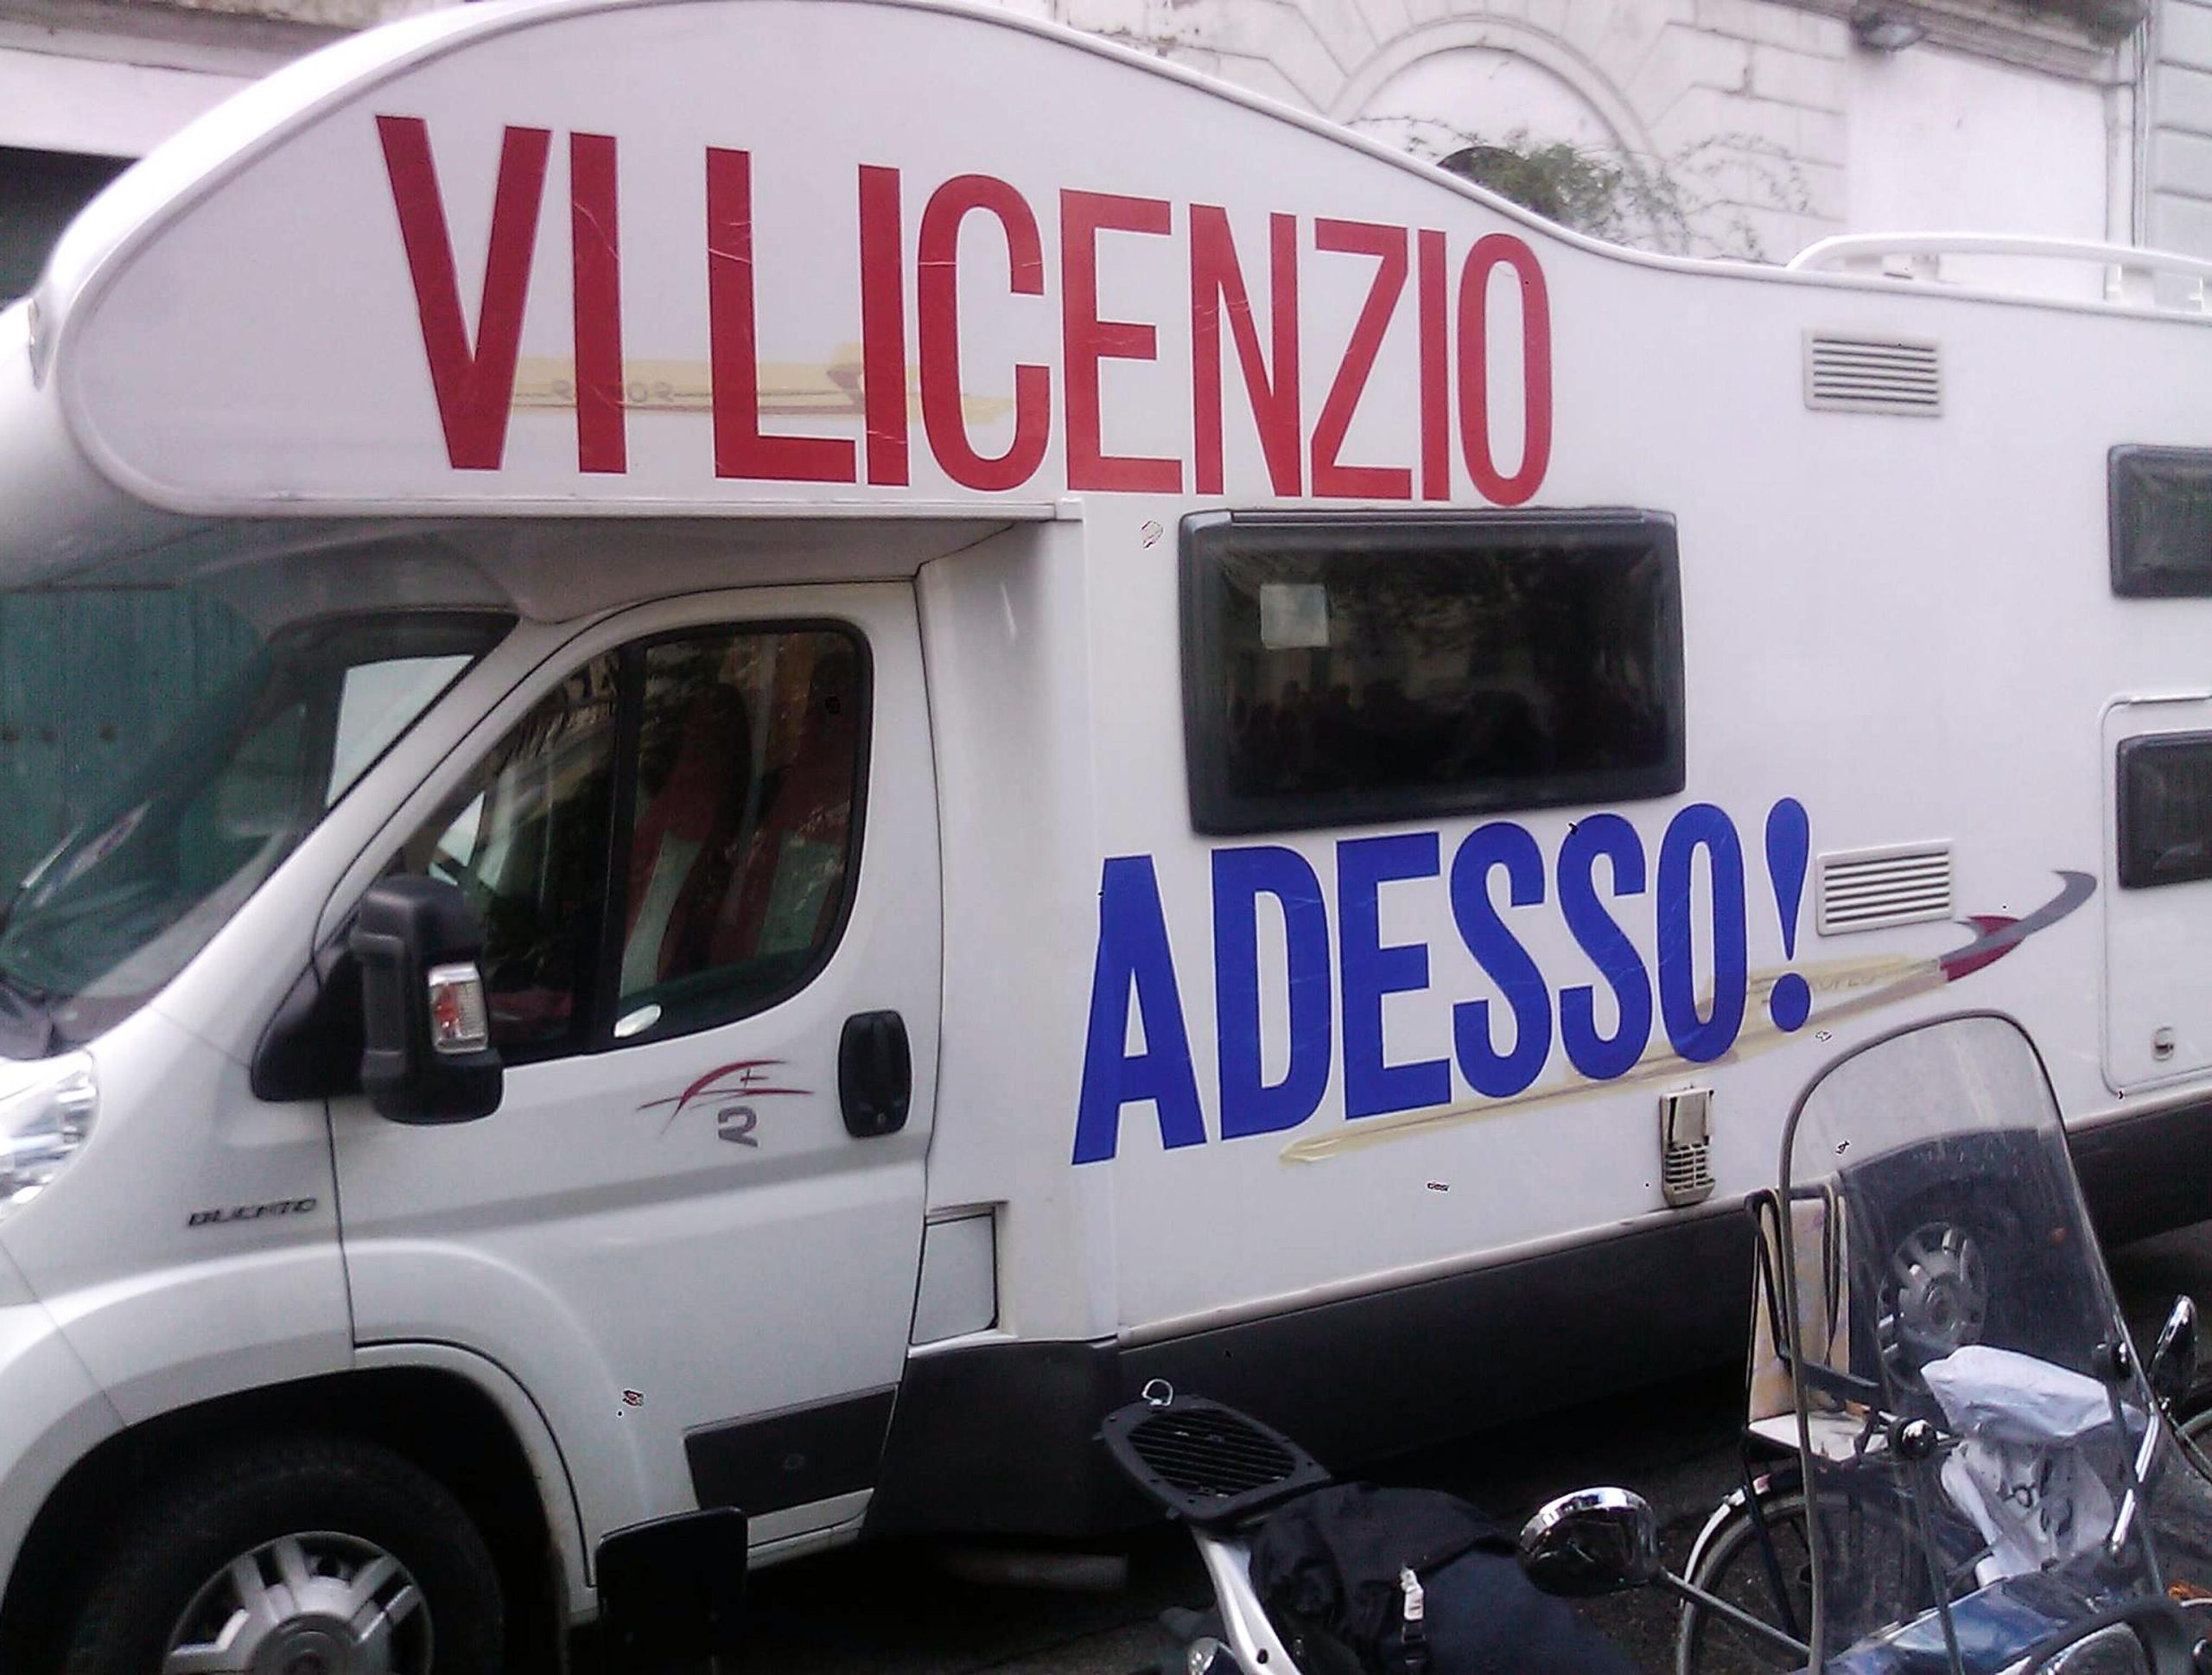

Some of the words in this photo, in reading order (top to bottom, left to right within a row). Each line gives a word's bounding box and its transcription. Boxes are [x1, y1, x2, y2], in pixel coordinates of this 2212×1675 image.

[376, 116, 627, 474] VI
[705, 146, 1553, 506] LICENZIO
[1071, 798, 1811, 1165] ADESSO!
